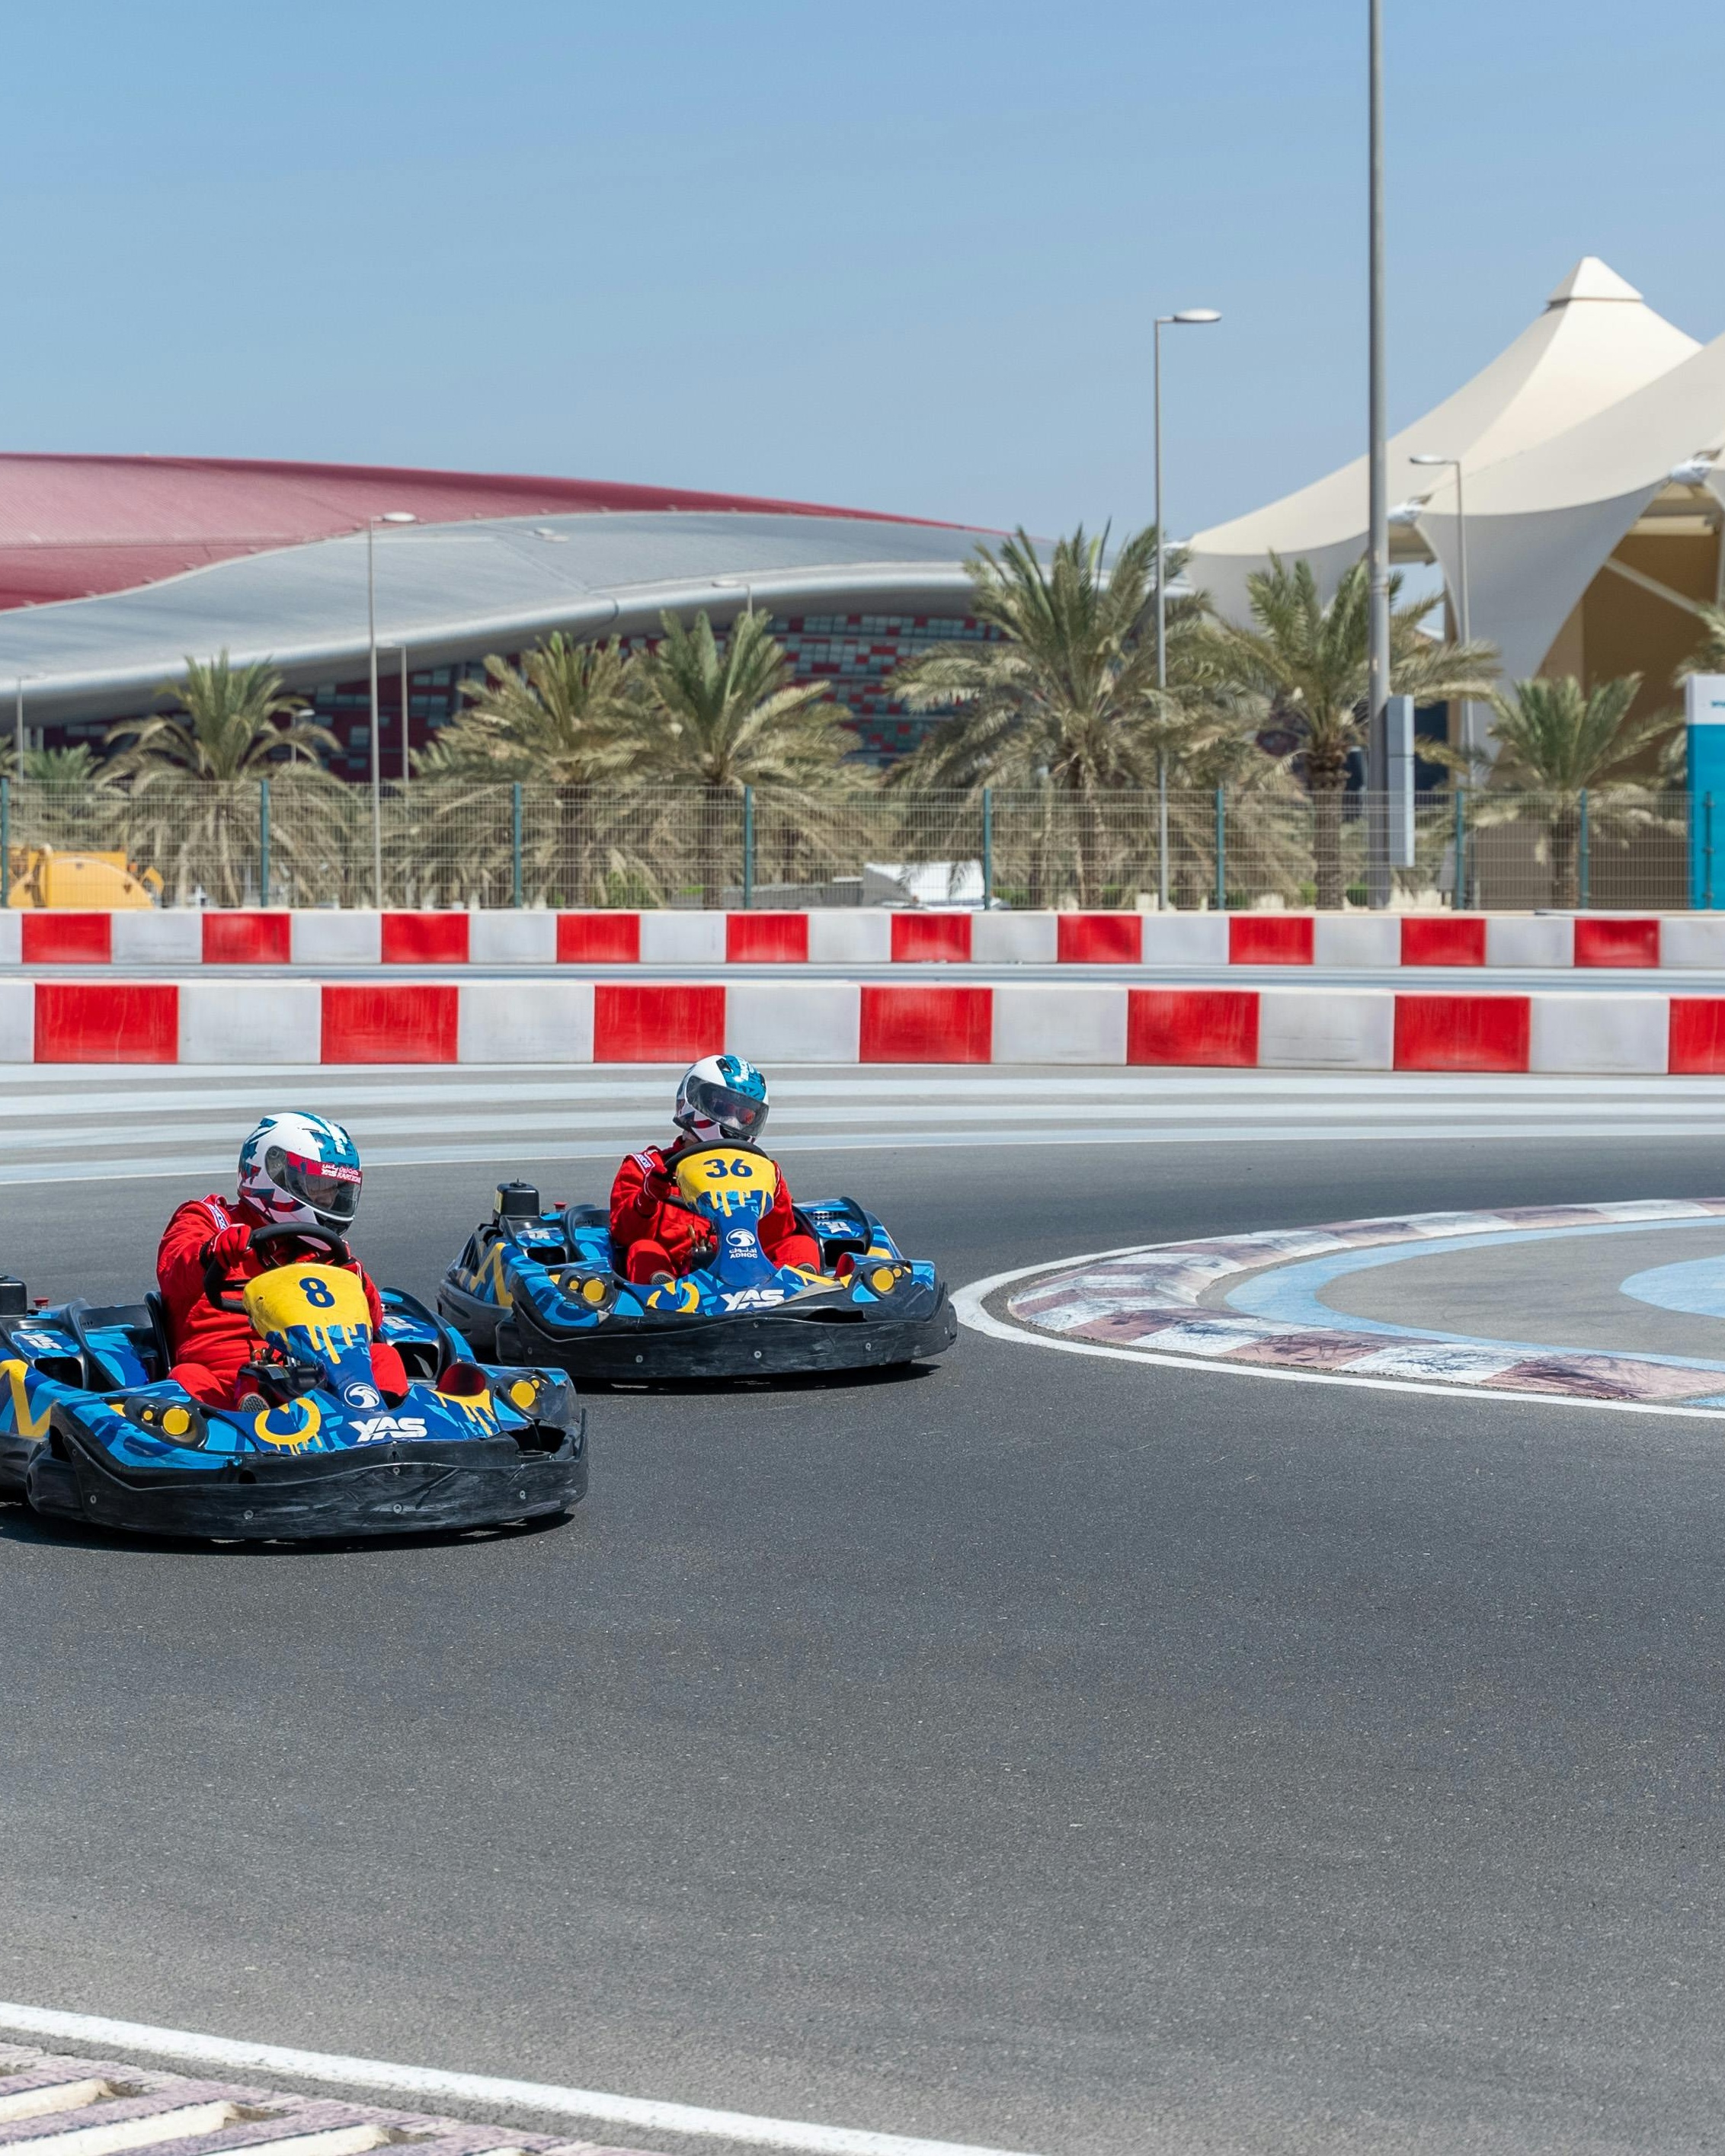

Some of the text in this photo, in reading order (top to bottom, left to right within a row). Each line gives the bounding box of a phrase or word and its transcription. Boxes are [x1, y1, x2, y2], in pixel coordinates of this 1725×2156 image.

[703, 1159, 753, 1178] 36
[299, 1277, 335, 1308] 8
[720, 1289, 785, 1312] YAS
[348, 1416, 427, 1442] YAS
